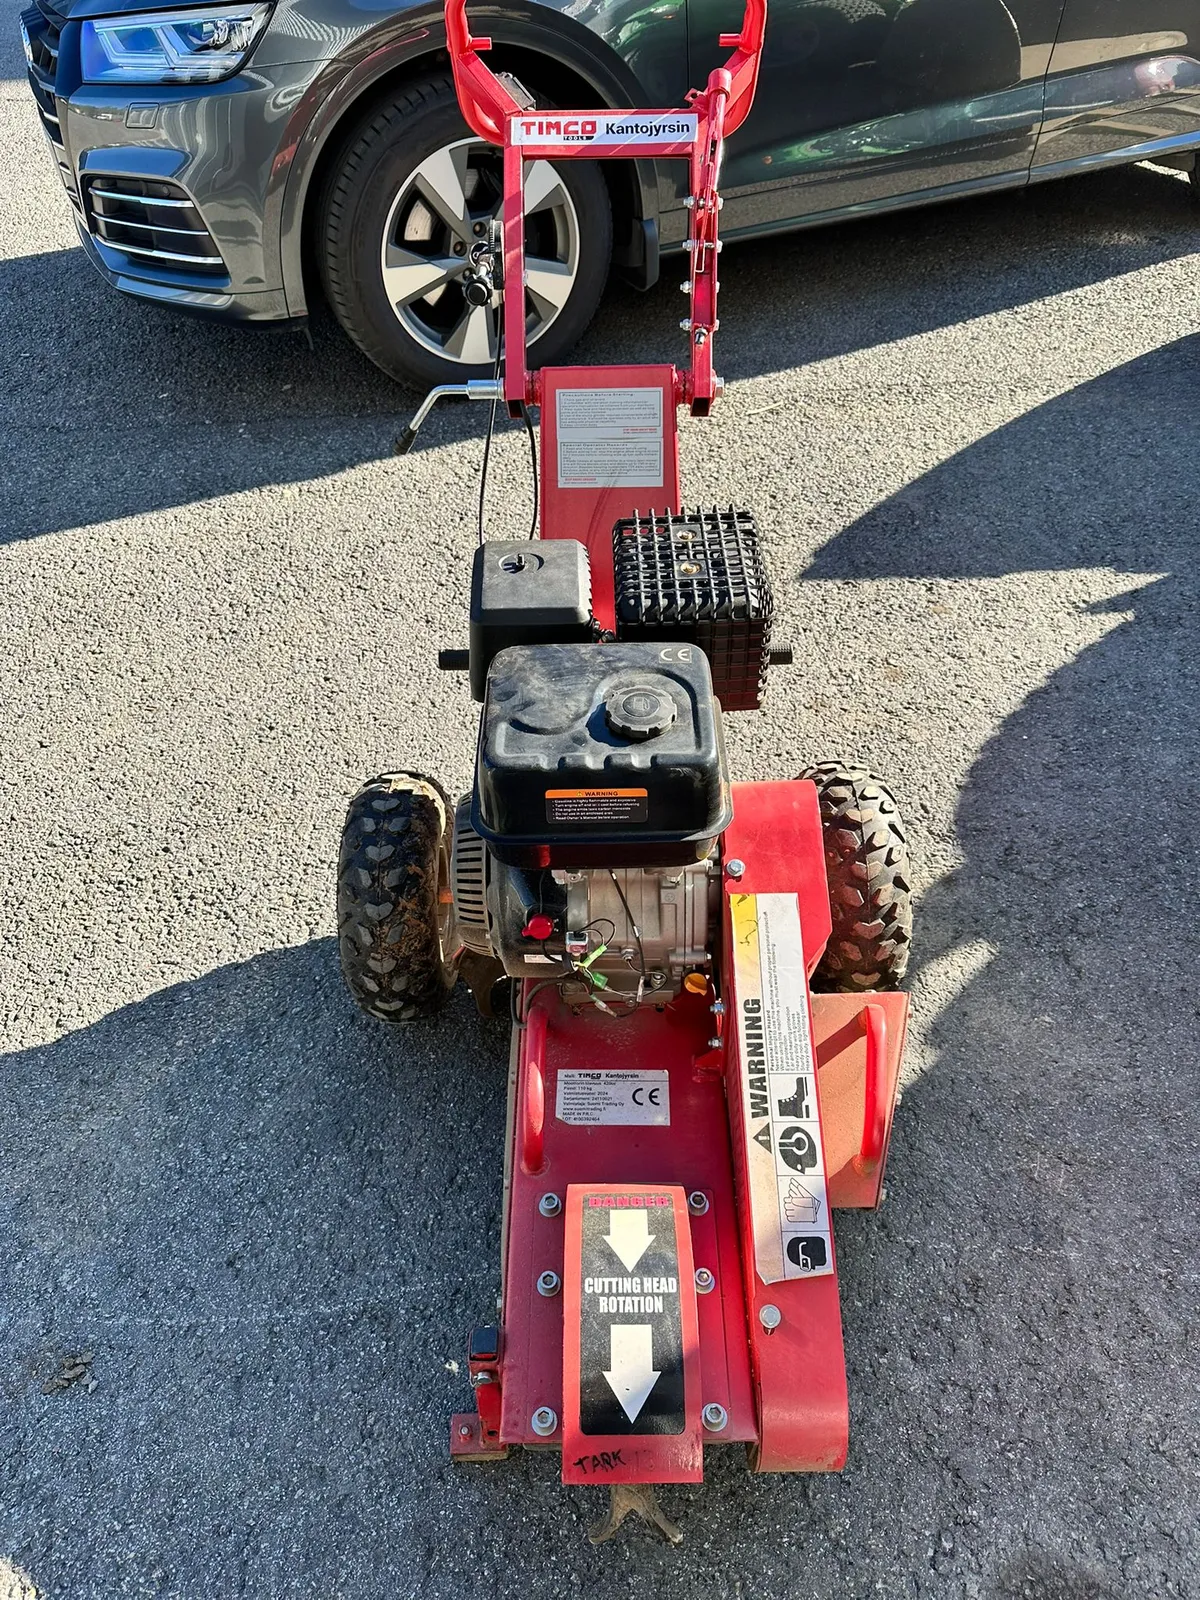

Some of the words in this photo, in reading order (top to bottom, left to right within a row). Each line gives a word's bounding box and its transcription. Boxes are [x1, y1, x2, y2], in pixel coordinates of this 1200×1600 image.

[521, 120, 596, 135] TIMCO
[606, 121, 689, 136] Kantojyrsin
[742, 998, 769, 1119] WARNING
[632, 1087, 660, 1106] CE
[589, 1197, 669, 1207] DANGER
[584, 1277, 641, 1293] CUTTING
[643, 1277, 677, 1293] HEAD
[599, 1296, 663, 1313] ROTATION
[573, 1449, 626, 1474] TARK
